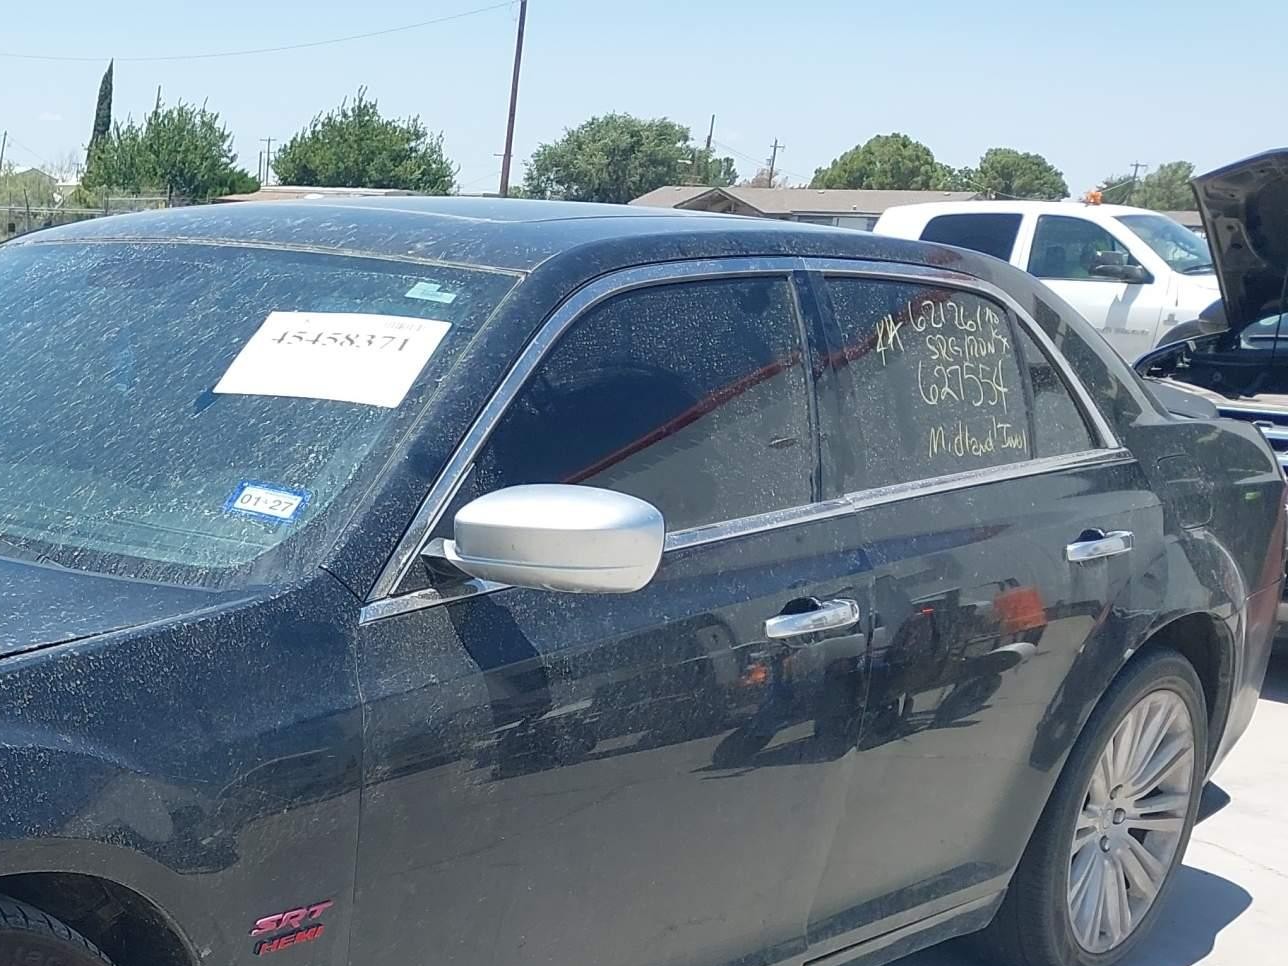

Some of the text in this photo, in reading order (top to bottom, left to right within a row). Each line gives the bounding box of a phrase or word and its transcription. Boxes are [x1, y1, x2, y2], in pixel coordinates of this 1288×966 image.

[272, 330, 410, 352] 45458371
[918, 359, 1008, 415] 627554
[250, 899, 333, 937] SRT
